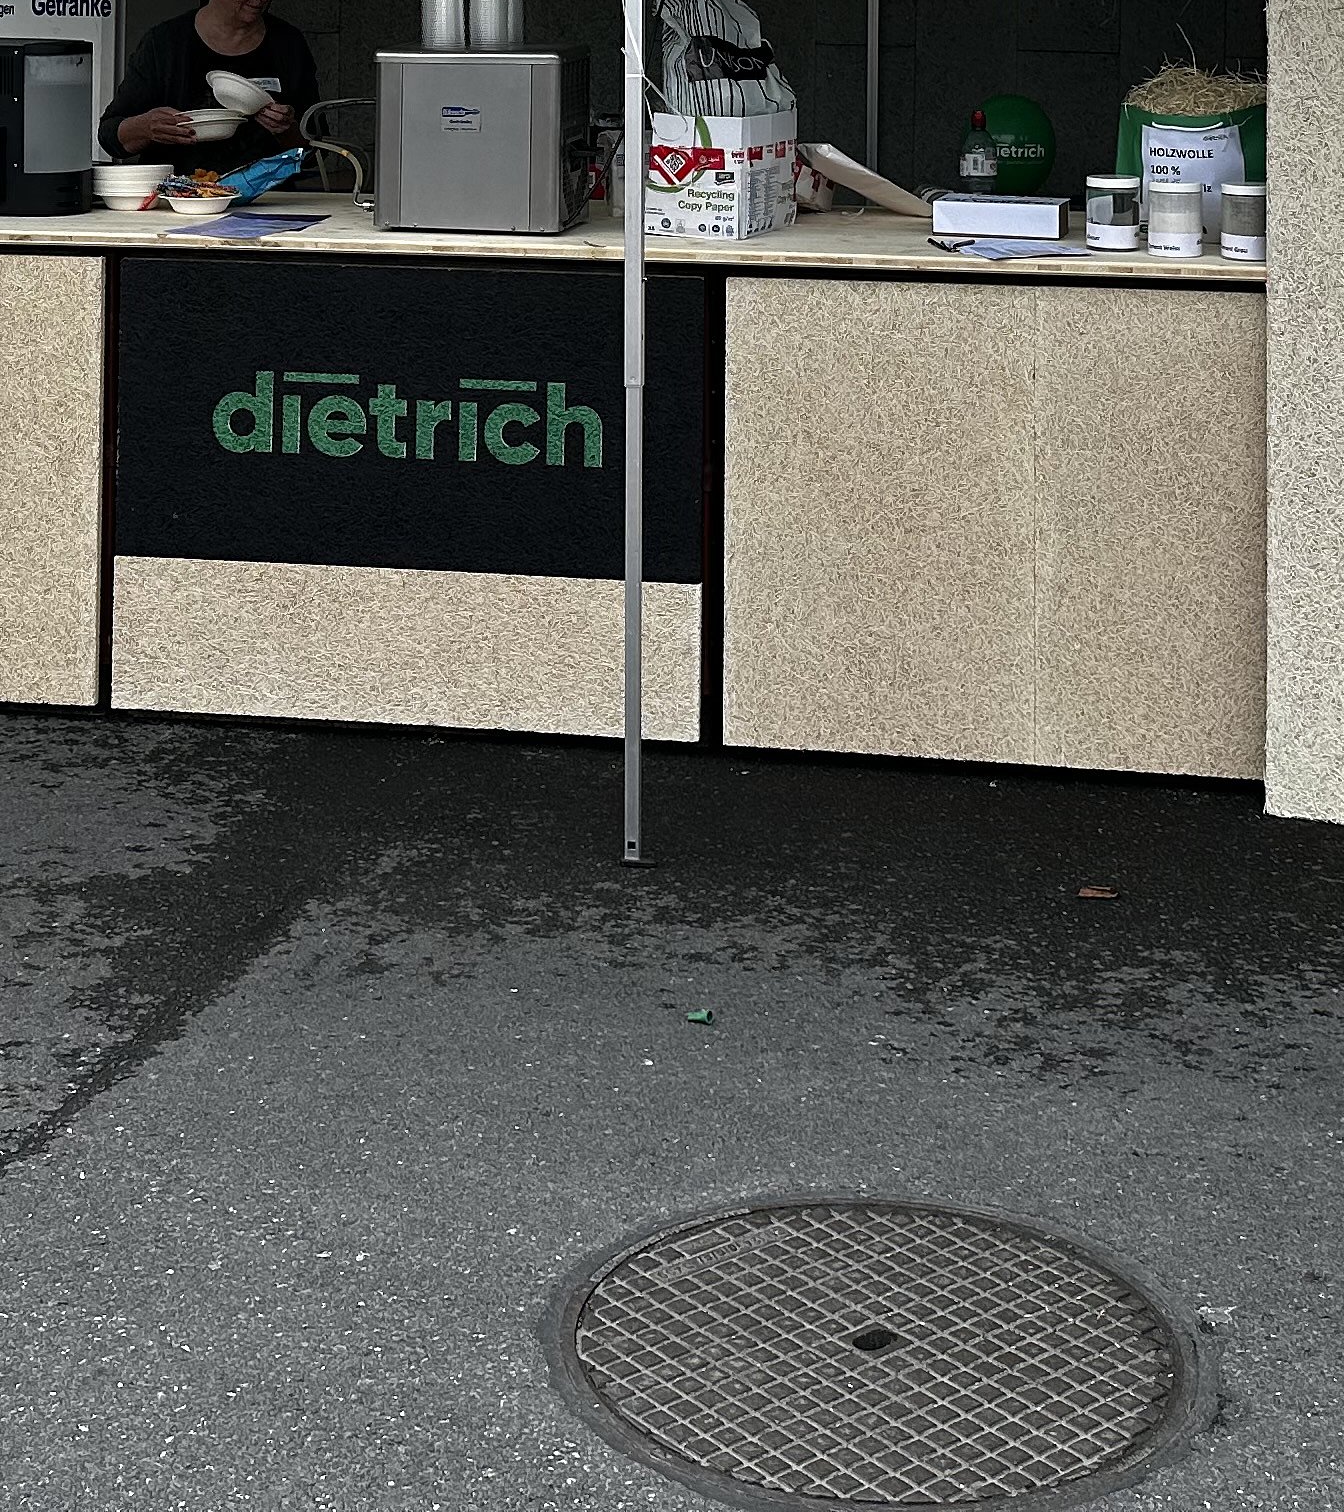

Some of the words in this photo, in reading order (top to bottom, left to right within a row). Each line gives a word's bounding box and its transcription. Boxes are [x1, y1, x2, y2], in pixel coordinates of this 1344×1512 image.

[997, 143, 1044, 157] ietrich
[1149, 147, 1214, 159] HOLZWOLLE
[1150, 165, 1169, 175] 100
[1171, 165, 1181, 176] %
[687, 188, 735, 202] Recycling
[678, 201, 703, 212] Copy
[706, 201, 735, 213] Paper
[212, 370, 603, 468] dietrich
